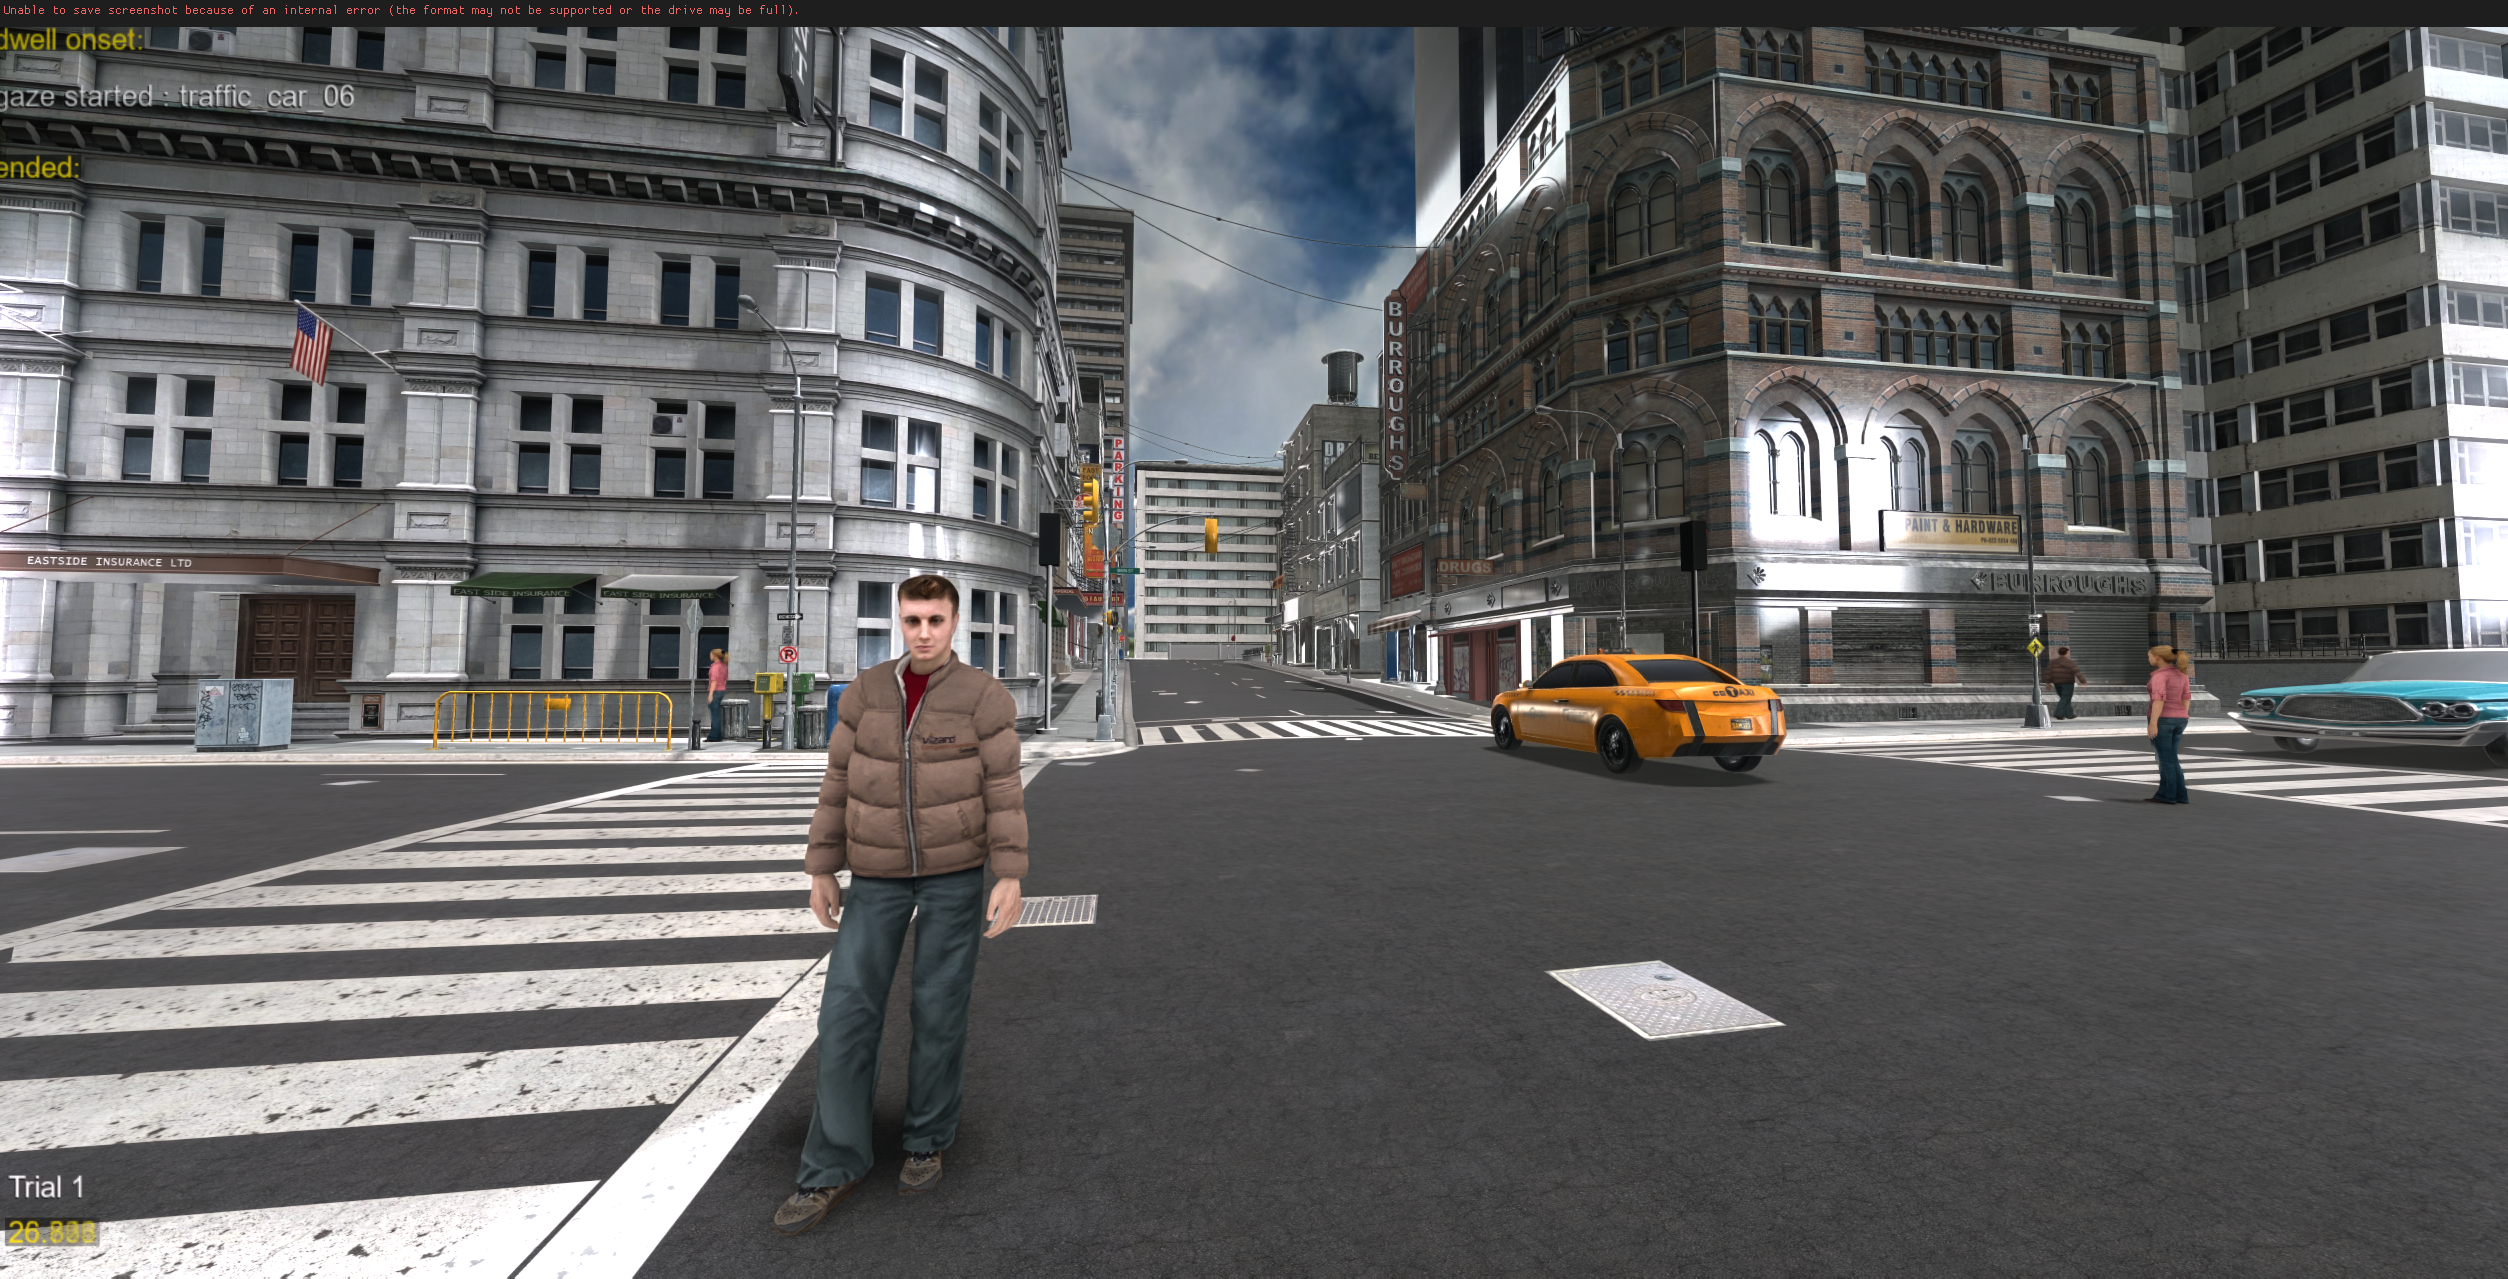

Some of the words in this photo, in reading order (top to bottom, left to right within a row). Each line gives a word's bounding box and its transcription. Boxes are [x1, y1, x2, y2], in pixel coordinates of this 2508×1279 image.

[1388, 301, 1405, 471] BURROUGHS
[1114, 438, 1123, 520] PARKING
[1904, 517, 1938, 533] PAINT
[1943, 518, 1951, 533] &
[1955, 519, 2018, 535] HARDWARE
[27, 556, 88, 566] EASTSIDE
[95, 557, 163, 567] INSURANCE
[170, 559, 193, 568] LTD
[1439, 561, 1491, 573] DRUGS
[1991, 572, 2147, 595] BURROUGHS
[453, 588, 480, 596] EAST
[483, 589, 509, 597] SIDE
[512, 588, 571, 597] INSURANCE
[632, 591, 656, 599] SIDE
[659, 591, 715, 599] INSURANCE
